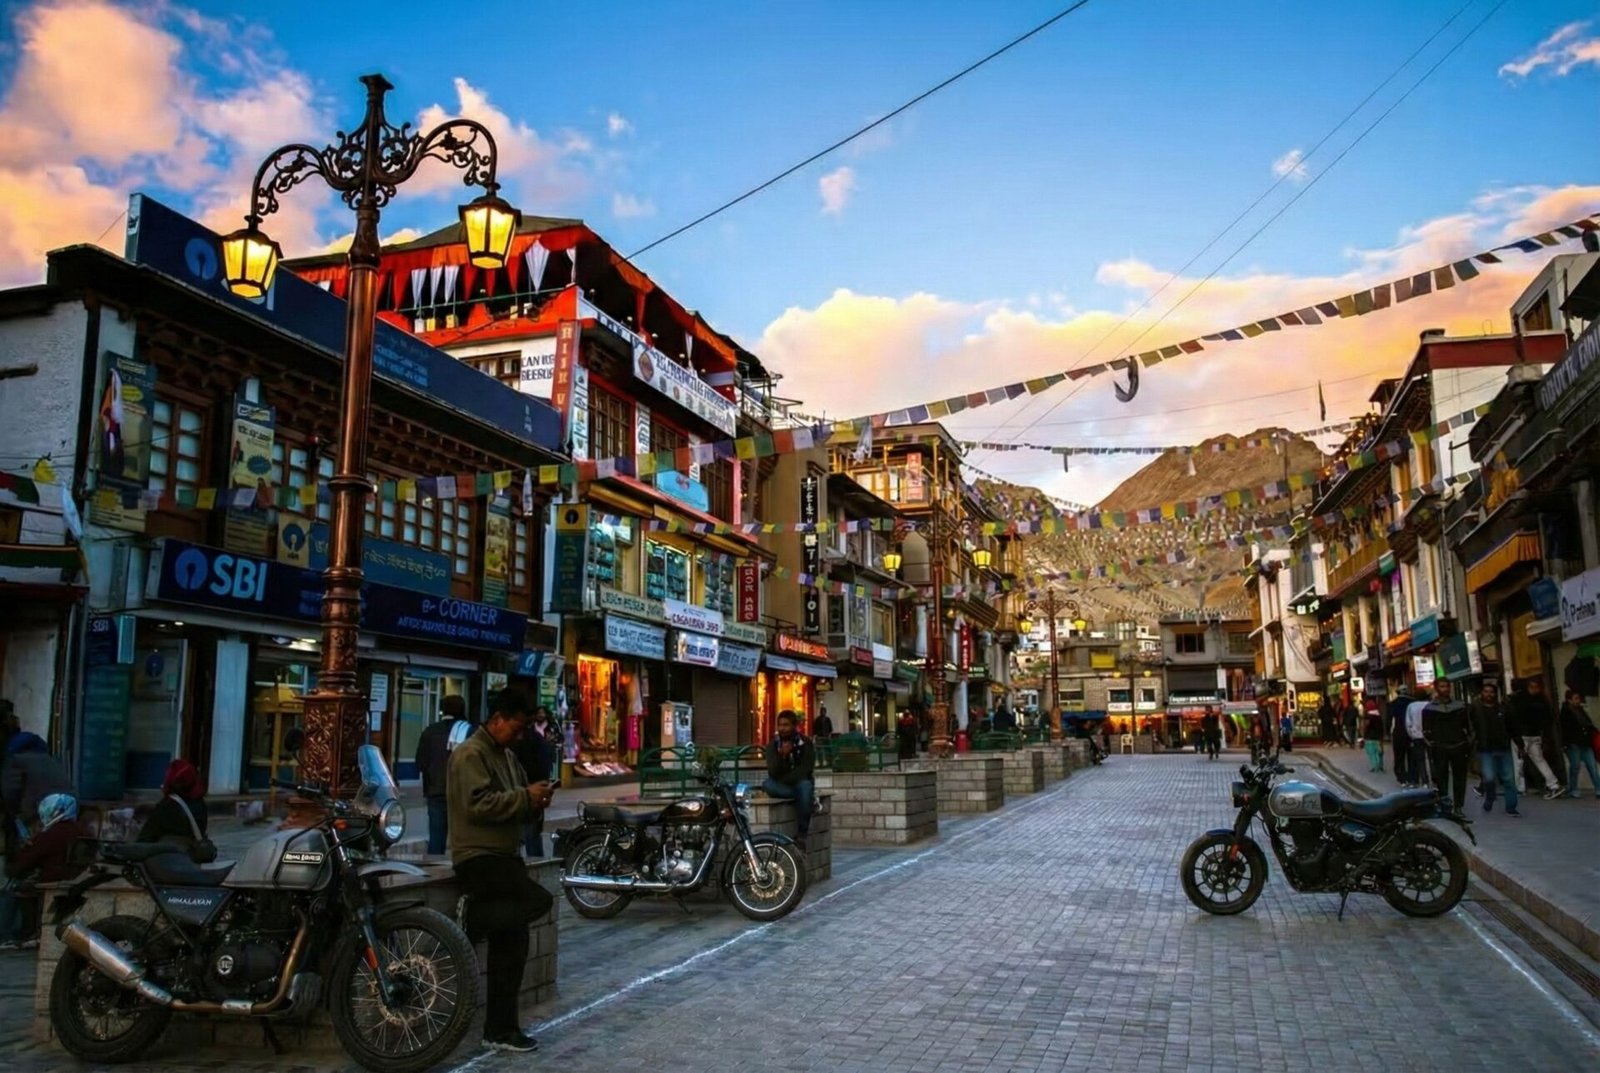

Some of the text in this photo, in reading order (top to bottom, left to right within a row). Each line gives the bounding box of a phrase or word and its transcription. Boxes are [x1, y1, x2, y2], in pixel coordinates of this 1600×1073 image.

[209, 553, 268, 602] SBI
[438, 597, 498, 625] CORNER
[167, 896, 212, 906] HIMALAYAN
